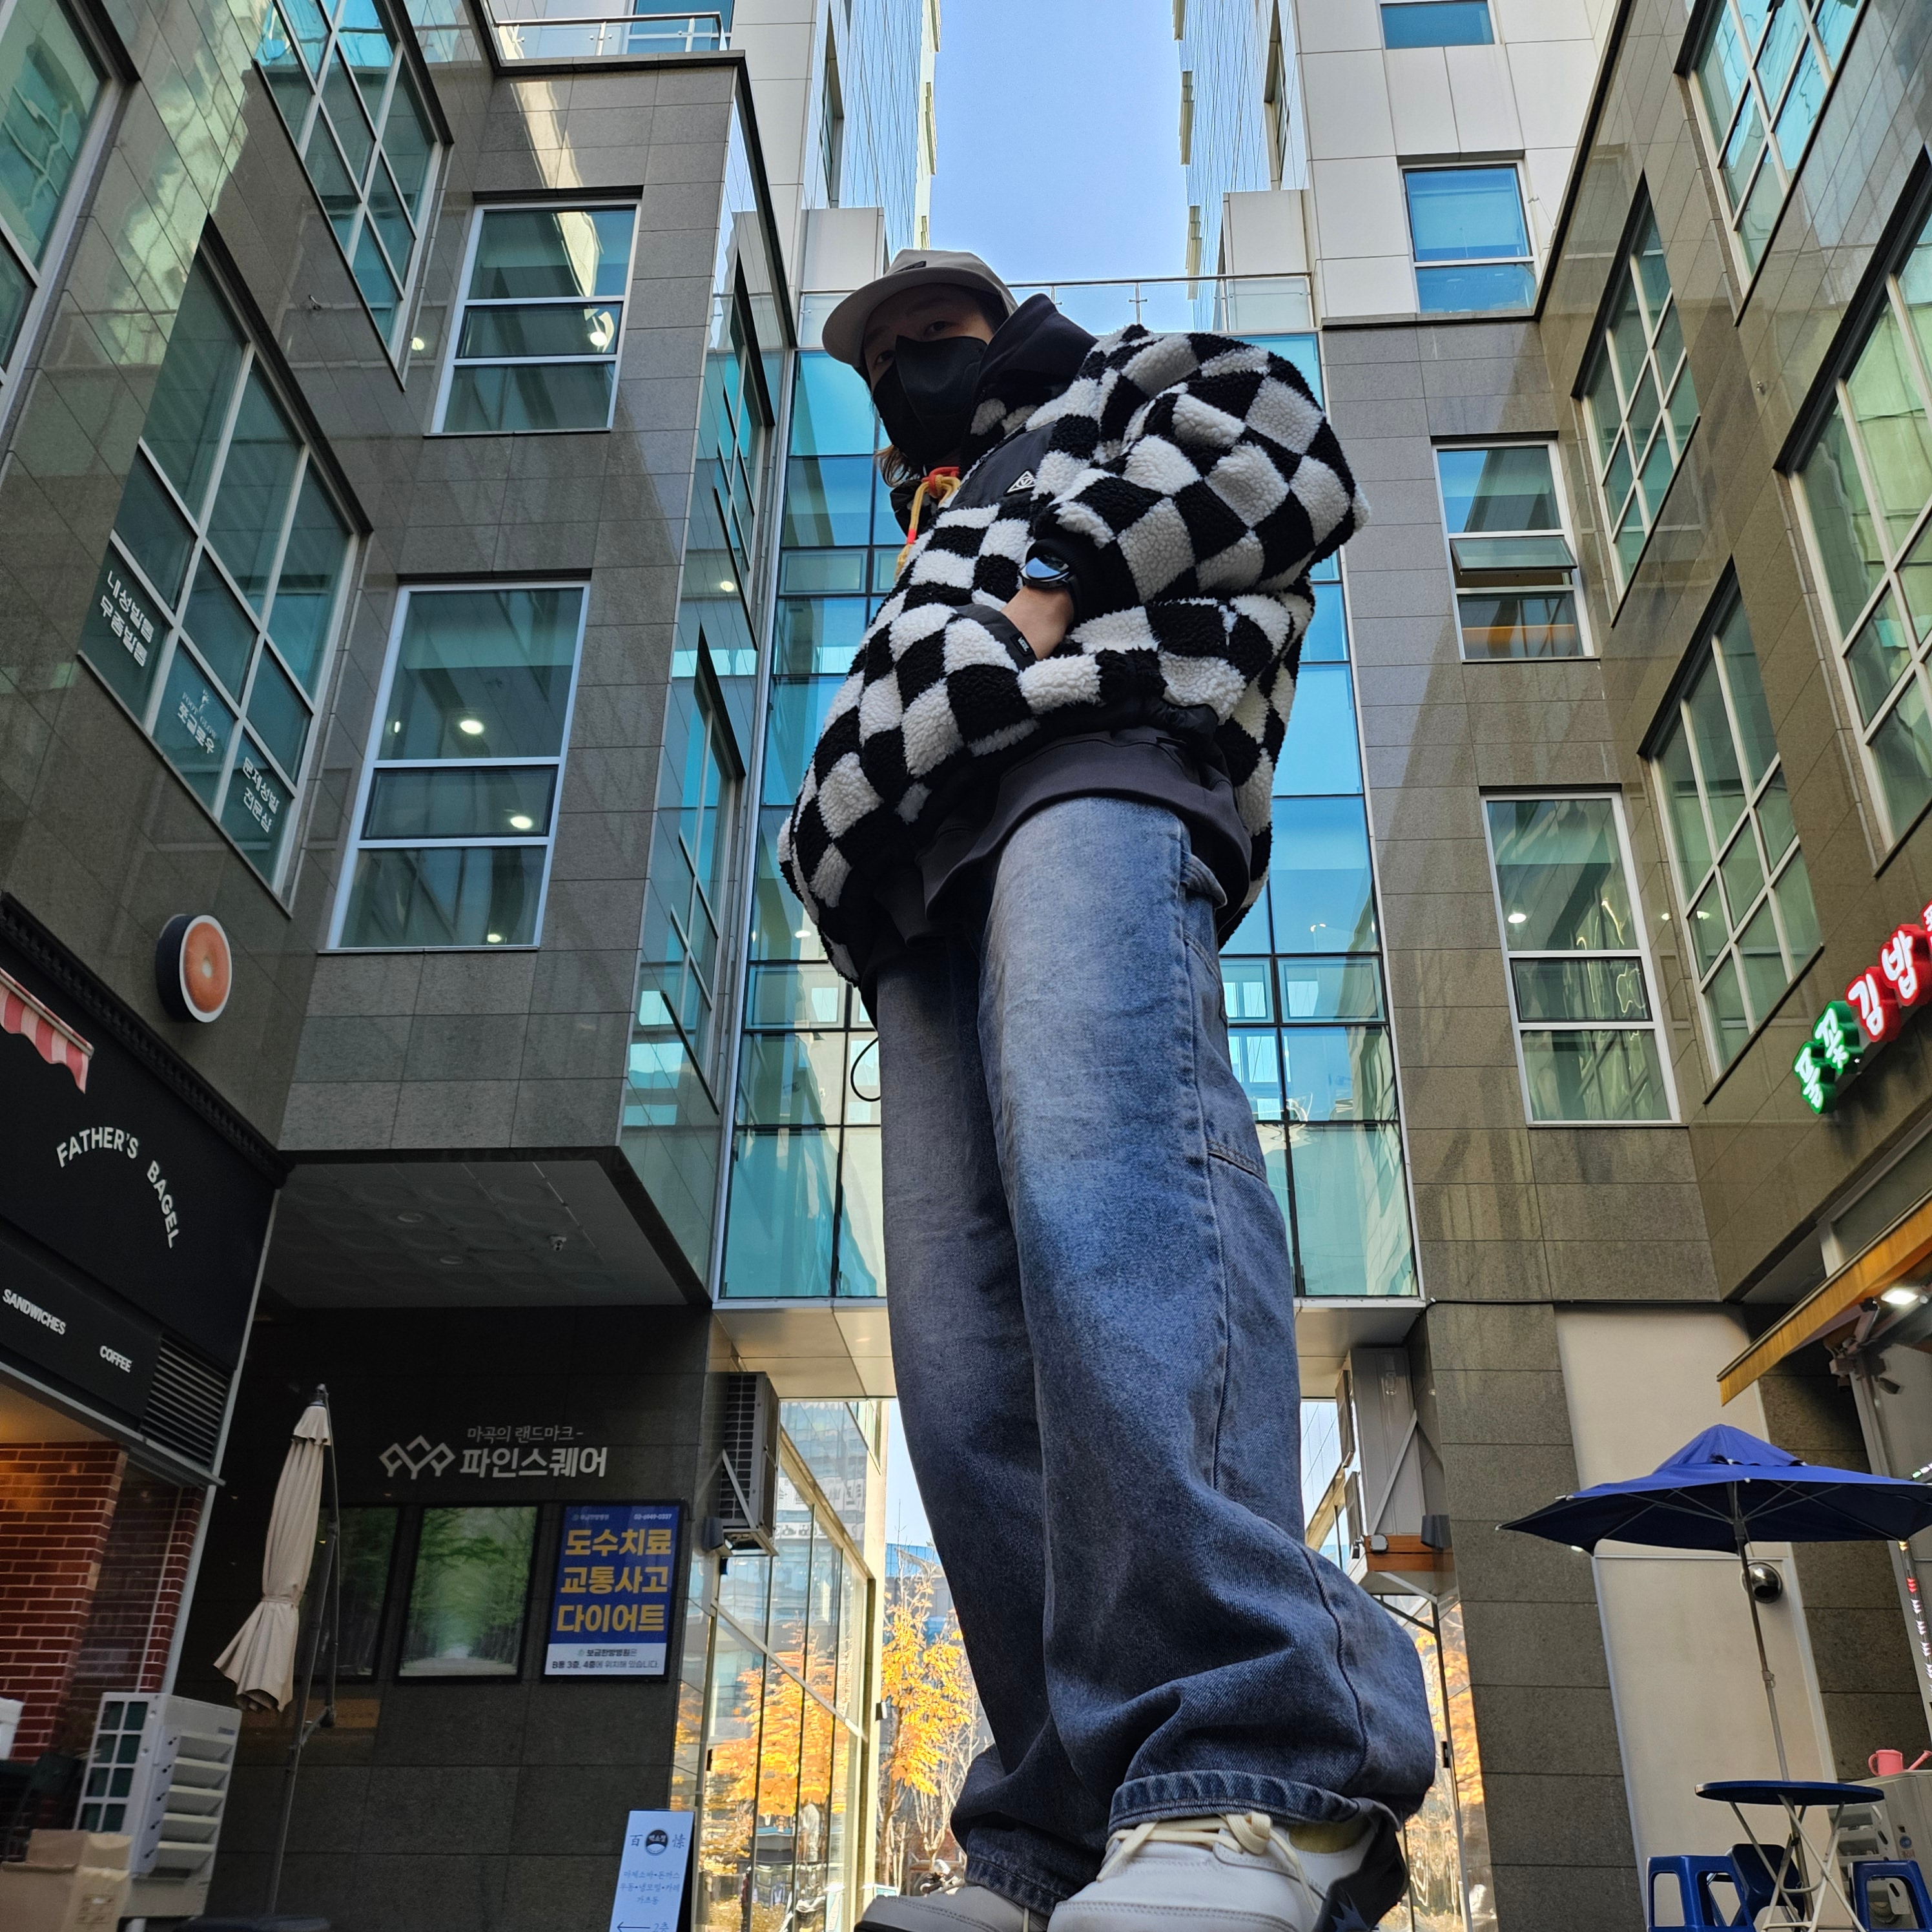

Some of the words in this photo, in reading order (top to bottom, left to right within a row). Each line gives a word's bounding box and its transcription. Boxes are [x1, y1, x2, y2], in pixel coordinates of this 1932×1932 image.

[107, 570, 154, 643] 내성발톱
[100, 595, 148, 667] 무좀발톱
[243, 756, 280, 814] 문제성발
[243, 787, 272, 833] 전문샵
[56, 1126, 139, 1168] FATHER'S
[147, 1160, 180, 1249] BAGEL
[3, 1289, 67, 1335] SANDWICHES
[99, 1345, 133, 1373] COFFEE
[468, 1425, 511, 1444] 마곡의
[459, 1447, 608, 1478] 파인스퀘어
[565, 1528, 672, 1556] 도수치료
[560, 1566, 668, 1594] 교통사고
[557, 1604, 665, 1632] 다이어트
[630, 1834, 644, 1847] 百
